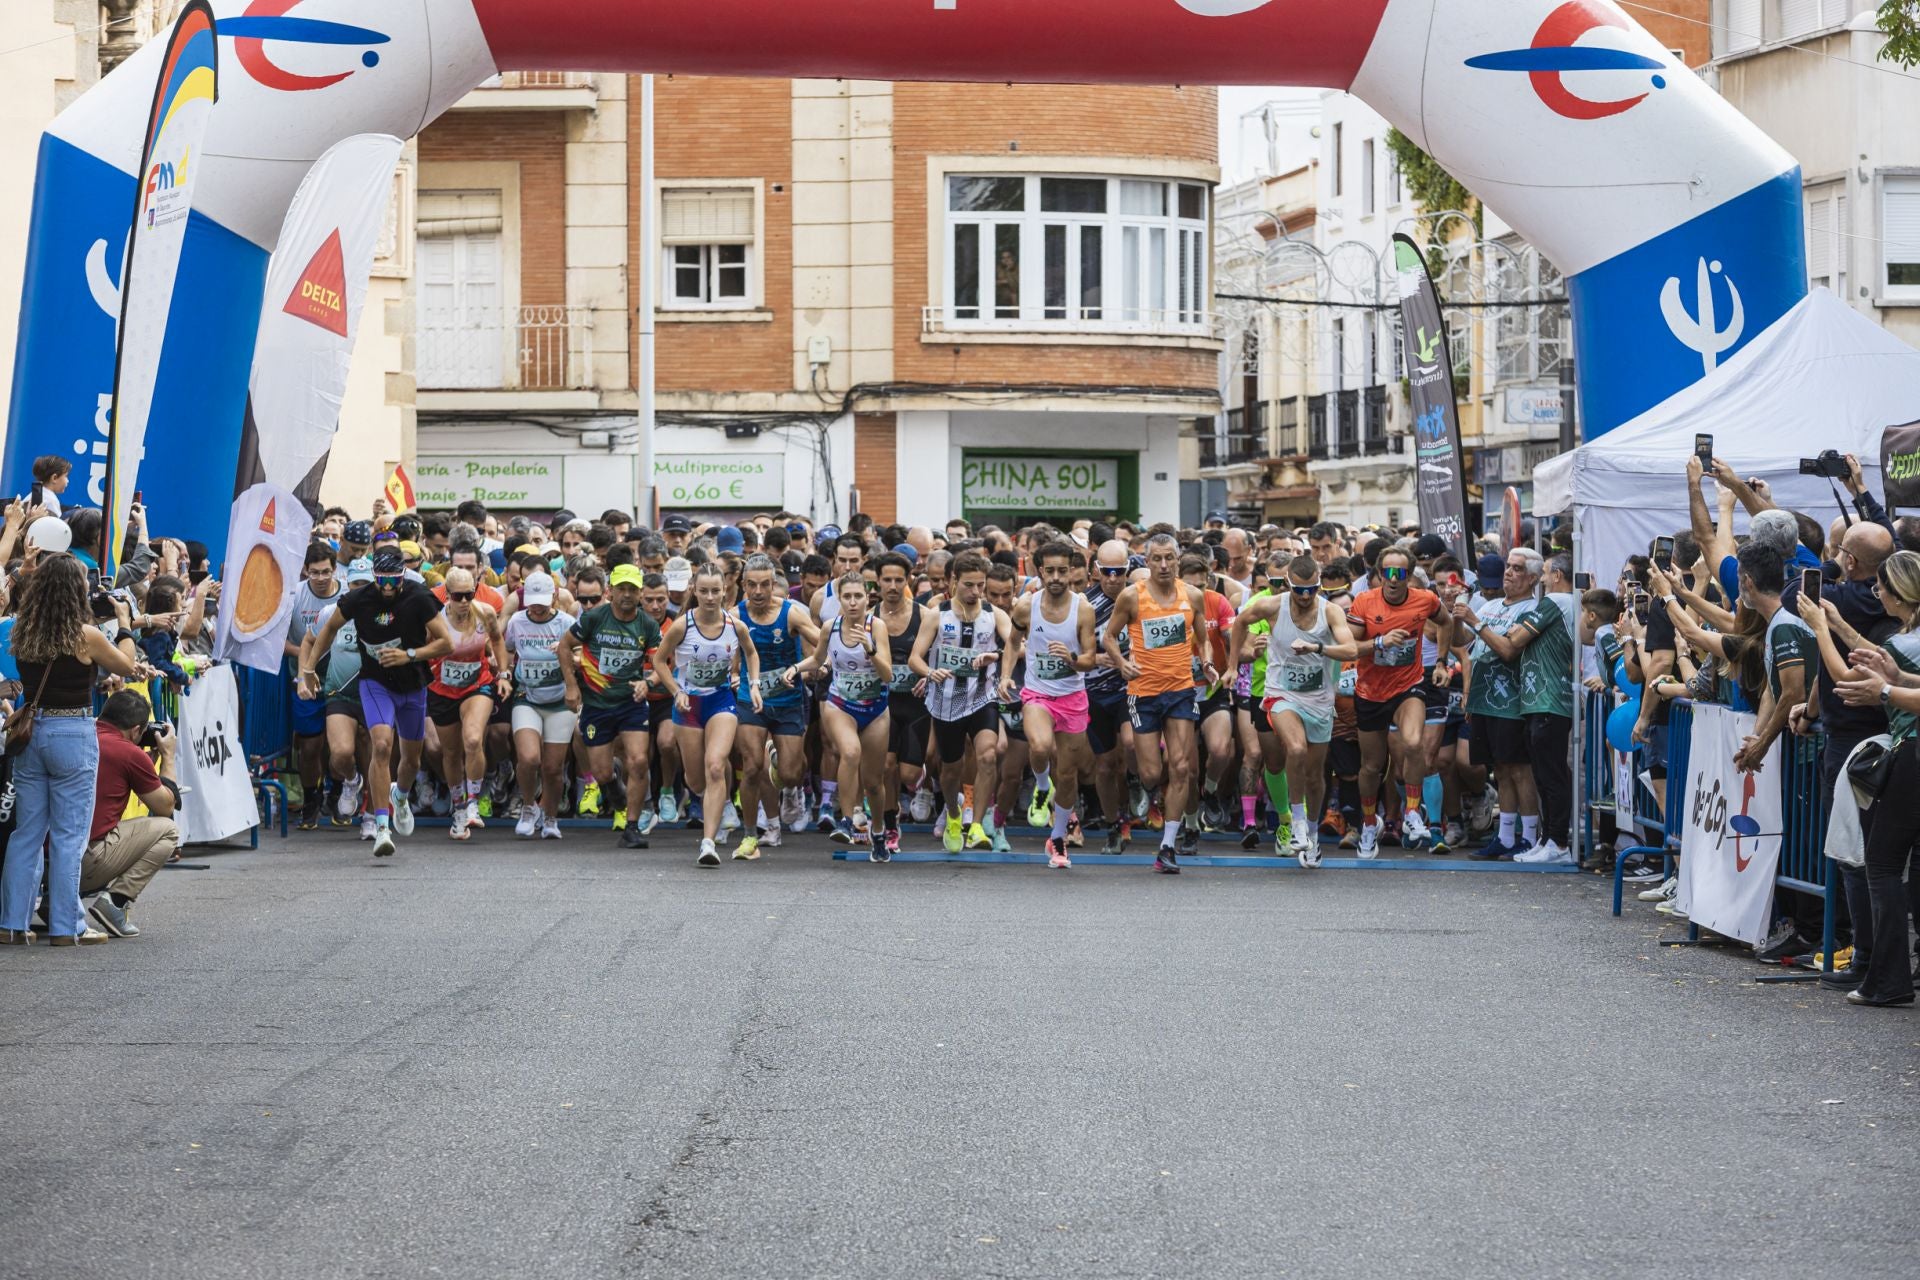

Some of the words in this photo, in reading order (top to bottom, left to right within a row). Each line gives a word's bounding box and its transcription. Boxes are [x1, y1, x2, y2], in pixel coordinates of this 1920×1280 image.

[301, 280, 341, 312] DELTA
[465, 461, 549, 479] Papelería
[654, 460, 764, 476] Multiprecios
[964, 461, 1050, 492] CHINA
[1057, 463, 1107, 493] SOL
[472, 487, 528, 501] Bazar
[672, 483, 721, 503] 0,60
[729, 479, 744, 499] €
[1034, 495, 1106, 507] Orientales
[1151, 624, 1179, 639] 984
[1288, 671, 1316, 684] 239
[845, 680, 873, 692] 749
